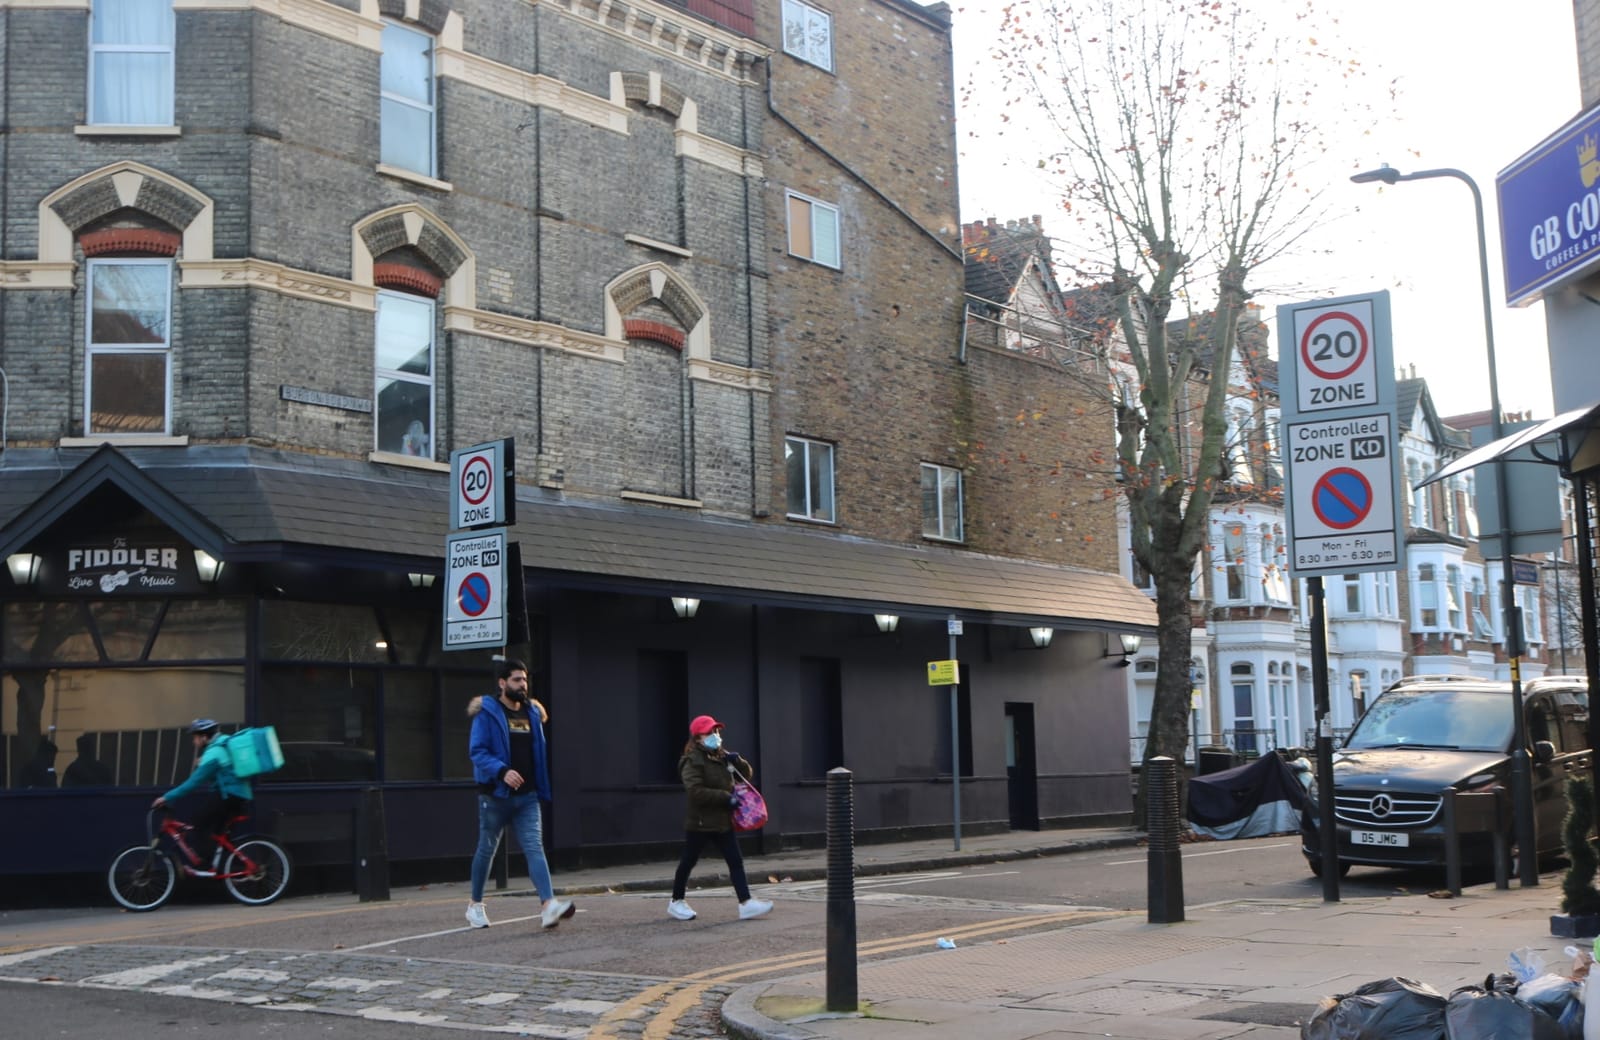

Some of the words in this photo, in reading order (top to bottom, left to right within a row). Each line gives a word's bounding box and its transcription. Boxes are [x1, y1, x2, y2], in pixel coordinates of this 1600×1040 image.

[1531, 215, 1561, 260] GB
[1566, 188, 1600, 239] CO
[1546, 243, 1580, 270] COFFEE
[1582, 239, 1589, 250] &
[1312, 331, 1357, 361] 20
[1310, 383, 1366, 405] ZONE
[1299, 420, 1379, 440] Controlled
[1294, 443, 1345, 463] ZONE
[1353, 438, 1382, 458] KD
[466, 469, 487, 492] 20
[464, 507, 490, 522] ZONE
[455, 539, 497, 553] Controlled
[1321, 542, 1342, 551] Mon
[1354, 539, 1367, 548] Fri
[68, 548, 178, 572] FIDDLER
[452, 555, 479, 569] ZONE
[483, 551, 499, 566] KD
[1299, 554, 1321, 564] 8.30
[1324, 552, 1339, 562] am
[1351, 550, 1373, 560] 6.30
[1377, 550, 1393, 559] pm
[68, 576, 94, 589] Live
[140, 575, 176, 587] Music
[1377, 834, 1397, 845] JMG
